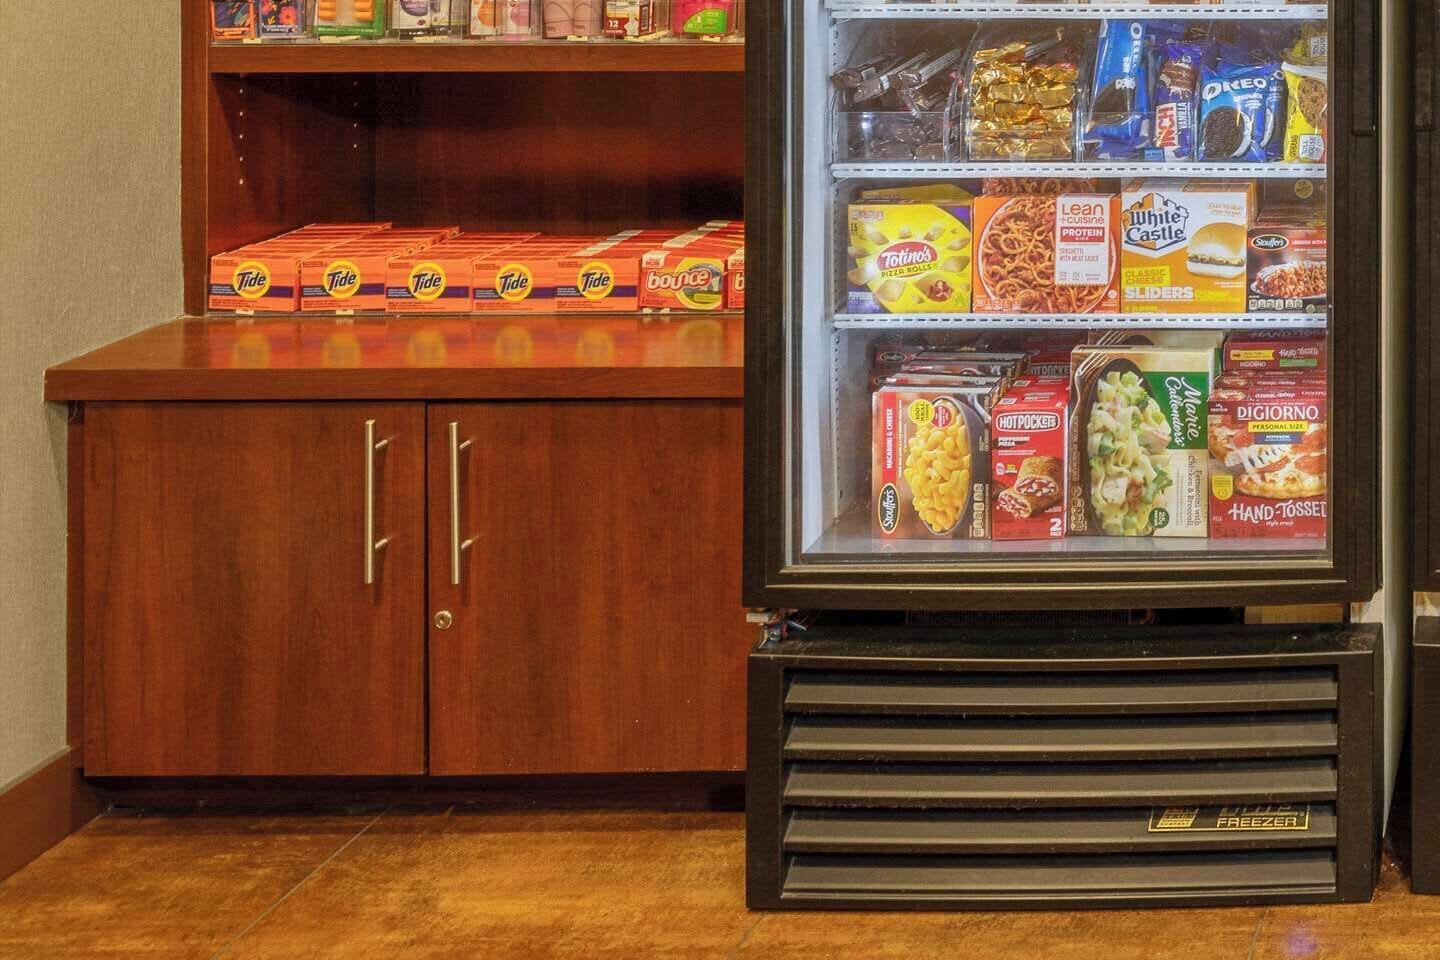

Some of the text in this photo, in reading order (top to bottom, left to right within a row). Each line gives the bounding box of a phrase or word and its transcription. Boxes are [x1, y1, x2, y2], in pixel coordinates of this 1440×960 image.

[1202, 78, 1266, 100] OREO
[1062, 204, 1104, 216] Lean
[1130, 211, 1180, 226] White
[1126, 228, 1184, 242] Castle
[1256, 238, 1284, 247] Stouffer's
[882, 246, 931, 268] Totino's
[237, 272, 266, 291] Tide
[327, 271, 356, 291] Tide
[412, 273, 441, 292] Tide
[500, 273, 528, 293] Tide
[582, 272, 610, 292] Tide
[648, 268, 712, 290] bounce
[881, 270, 904, 278] PIZZA
[1125, 287, 1193, 299] SLIDERS
[1166, 376, 1184, 447] Callender's
[1181, 377, 1202, 440] Marie
[1237, 406, 1319, 420] DIGIORNO
[1000, 415, 1056, 429] HOT POCKETS
[883, 490, 894, 528] Stouffer's
[1050, 518, 1062, 532] 2
[1217, 817, 1297, 827] FREEZER
